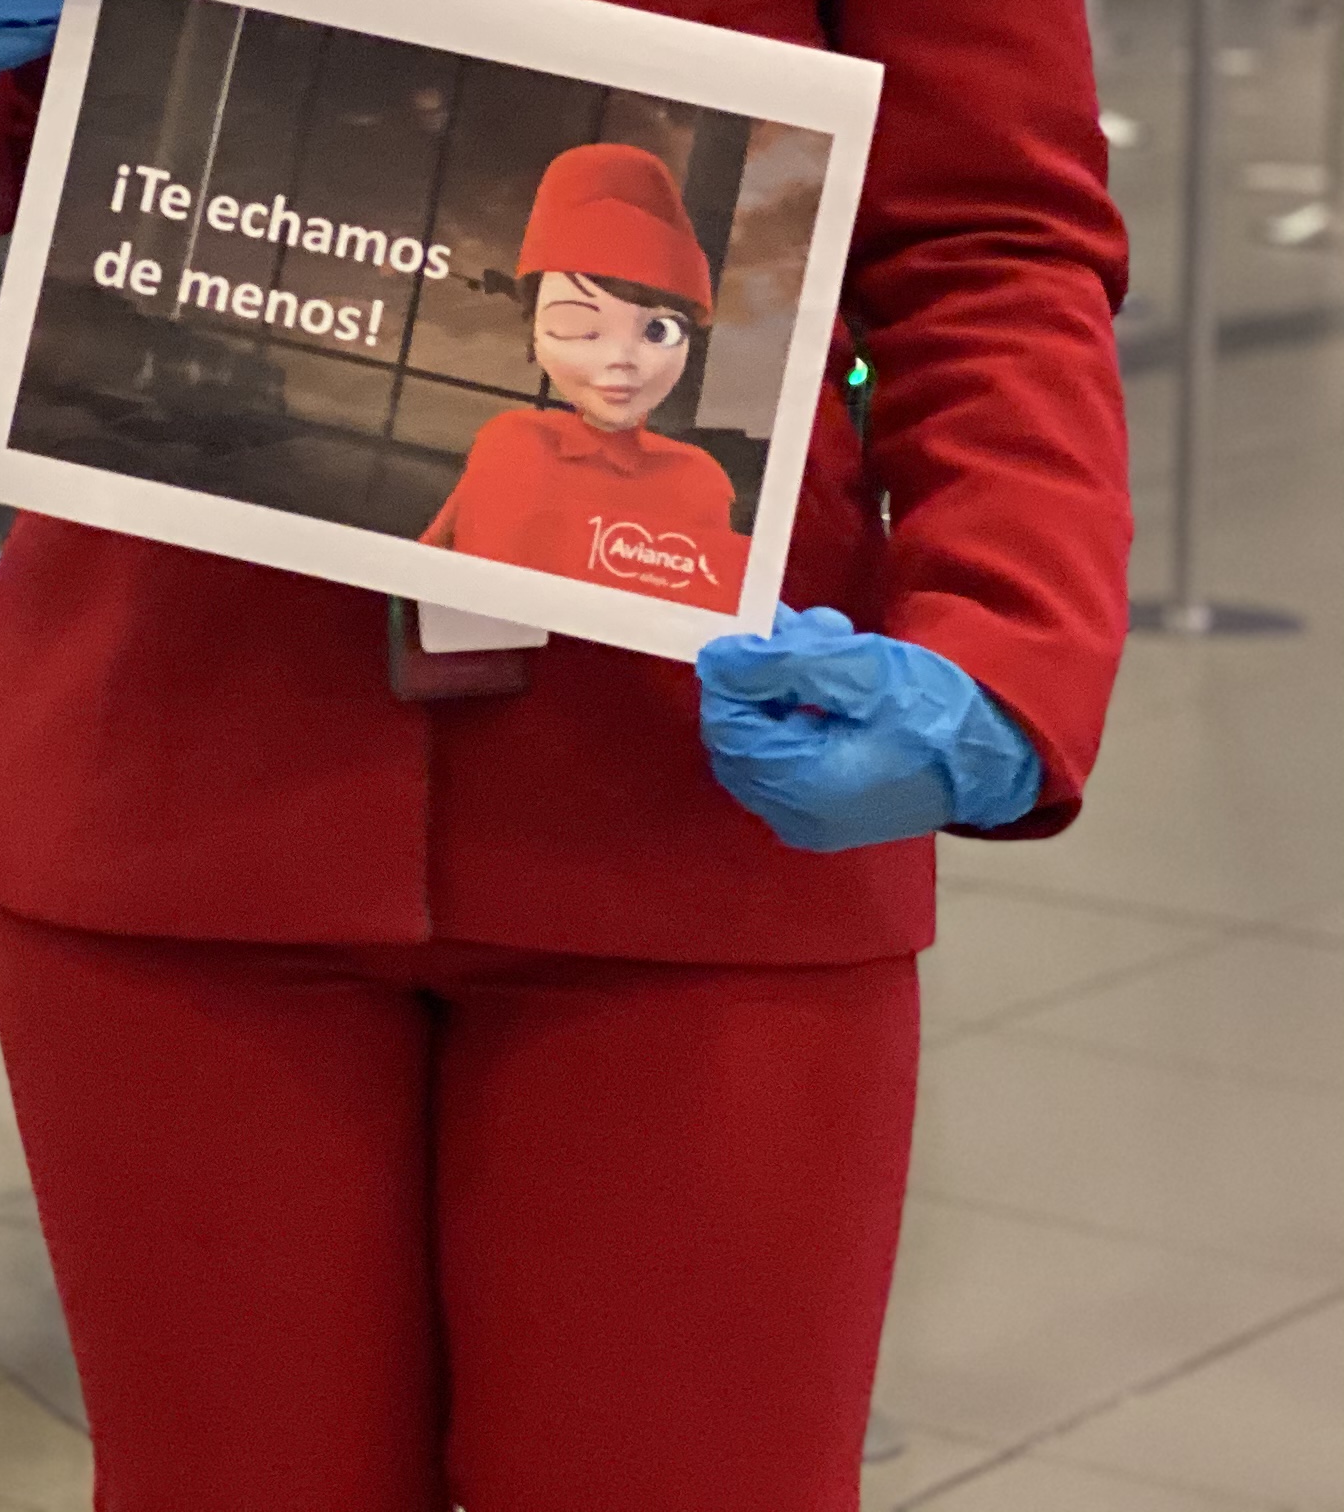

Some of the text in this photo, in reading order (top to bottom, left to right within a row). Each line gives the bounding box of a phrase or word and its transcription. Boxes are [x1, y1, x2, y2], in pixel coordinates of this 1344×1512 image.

[110, 163, 452, 280] ¡Te echamos
[93, 241, 385, 347] de menos!
[608, 537, 696, 574] Avianca
